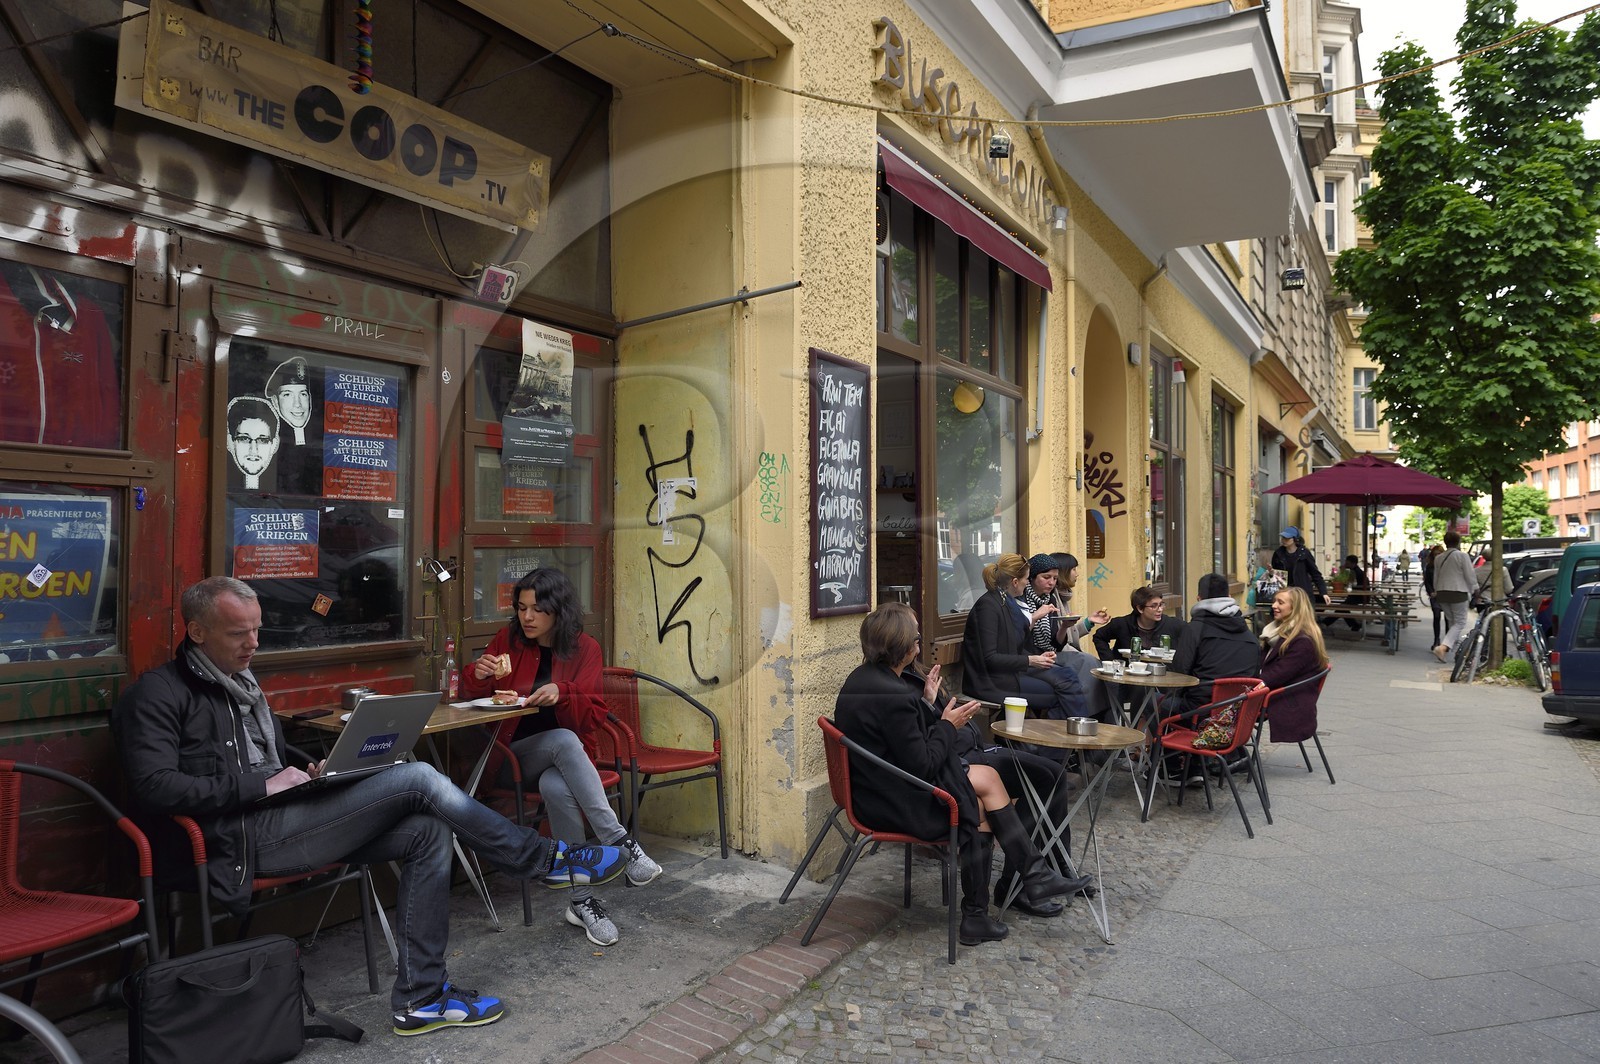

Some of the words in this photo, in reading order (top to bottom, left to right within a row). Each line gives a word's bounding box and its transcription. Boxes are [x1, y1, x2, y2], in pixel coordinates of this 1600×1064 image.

[199, 35, 242, 73] BAR
[234, 88, 286, 130] THE
[294, 85, 478, 188] COOP
[500, 275, 514, 300] 3
[334, 316, 385, 339] PRALL
[543, 333, 560, 344] WIEDER
[339, 373, 386, 387] SCHLUSS
[334, 382, 351, 391] MIT
[352, 383, 383, 393] EUREN
[344, 390, 389, 405] KRIEGEN
[338, 438, 385, 450] SCHLUSS
[333, 447, 349, 455] MIT
[351, 448, 382, 456] EUREN
[343, 454, 388, 468] KRIEGEN
[516, 476, 548, 487] KRIEGEN
[26, 508, 83, 519] PRÄSENTIERT
[85, 511, 103, 519] DAS
[245, 522, 264, 532] MIT
[266, 522, 300, 531] EURE
[256, 531, 308, 540] KRIEGEN
[819, 524, 853, 551] MANGO
[507, 556, 540, 566] SCHLUSS
[503, 565, 515, 573] MIT
[516, 563, 538, 572] EUREN
[362, 740, 394, 753] Intertek
